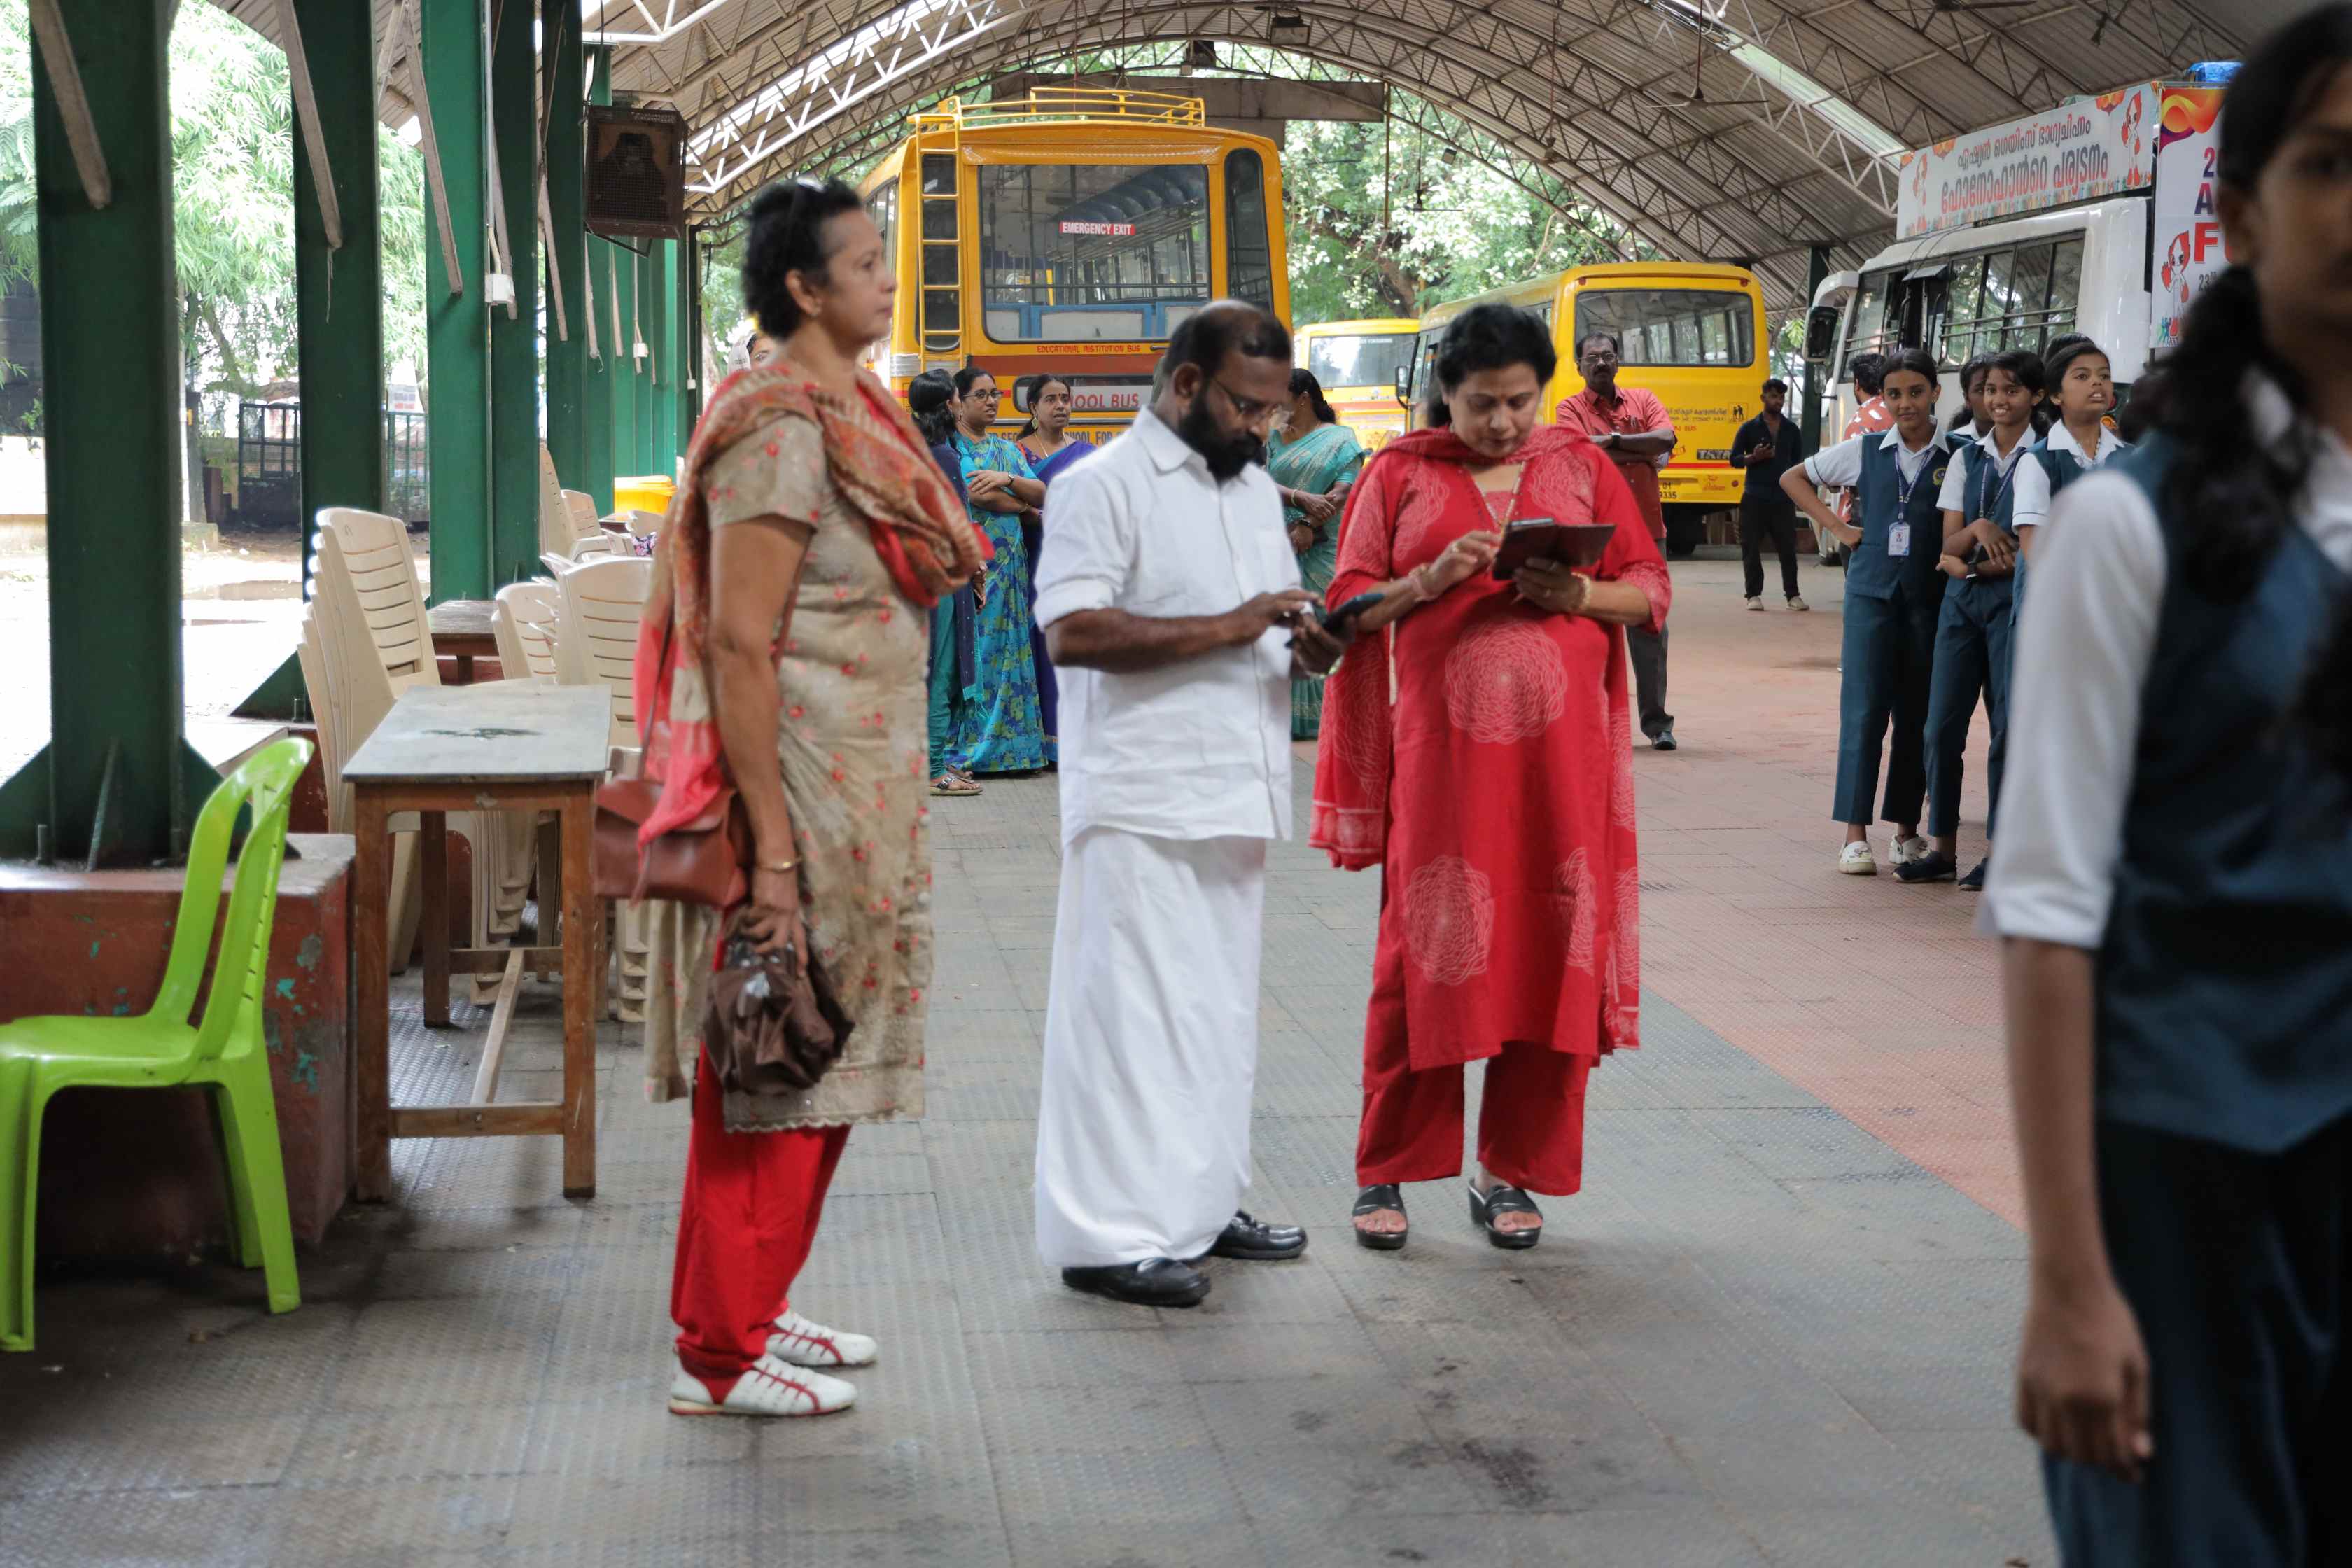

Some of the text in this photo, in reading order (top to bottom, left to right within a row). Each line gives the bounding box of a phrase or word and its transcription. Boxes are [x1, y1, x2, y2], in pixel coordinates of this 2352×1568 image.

[1063, 221, 1132, 235] EMERGENCY EXIT
[1111, 393, 1140, 408] BUS
